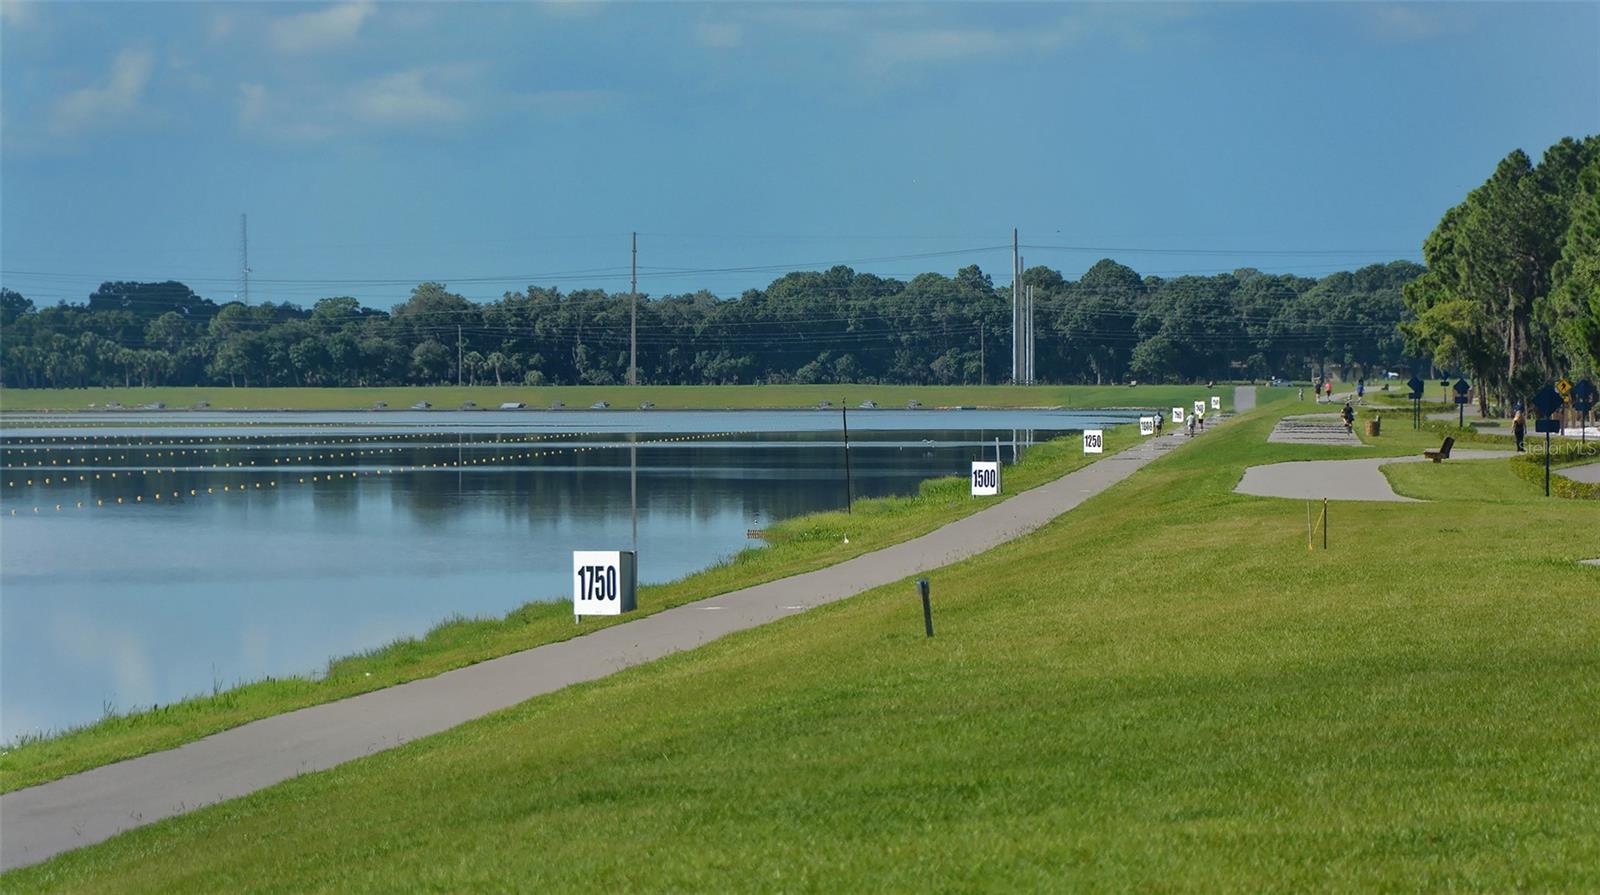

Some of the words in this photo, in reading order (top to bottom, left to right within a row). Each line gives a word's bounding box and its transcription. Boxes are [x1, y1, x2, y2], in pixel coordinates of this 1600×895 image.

[1085, 435, 1101, 448] 1250
[973, 469, 996, 488] 1500
[578, 565, 616, 601] 1750
